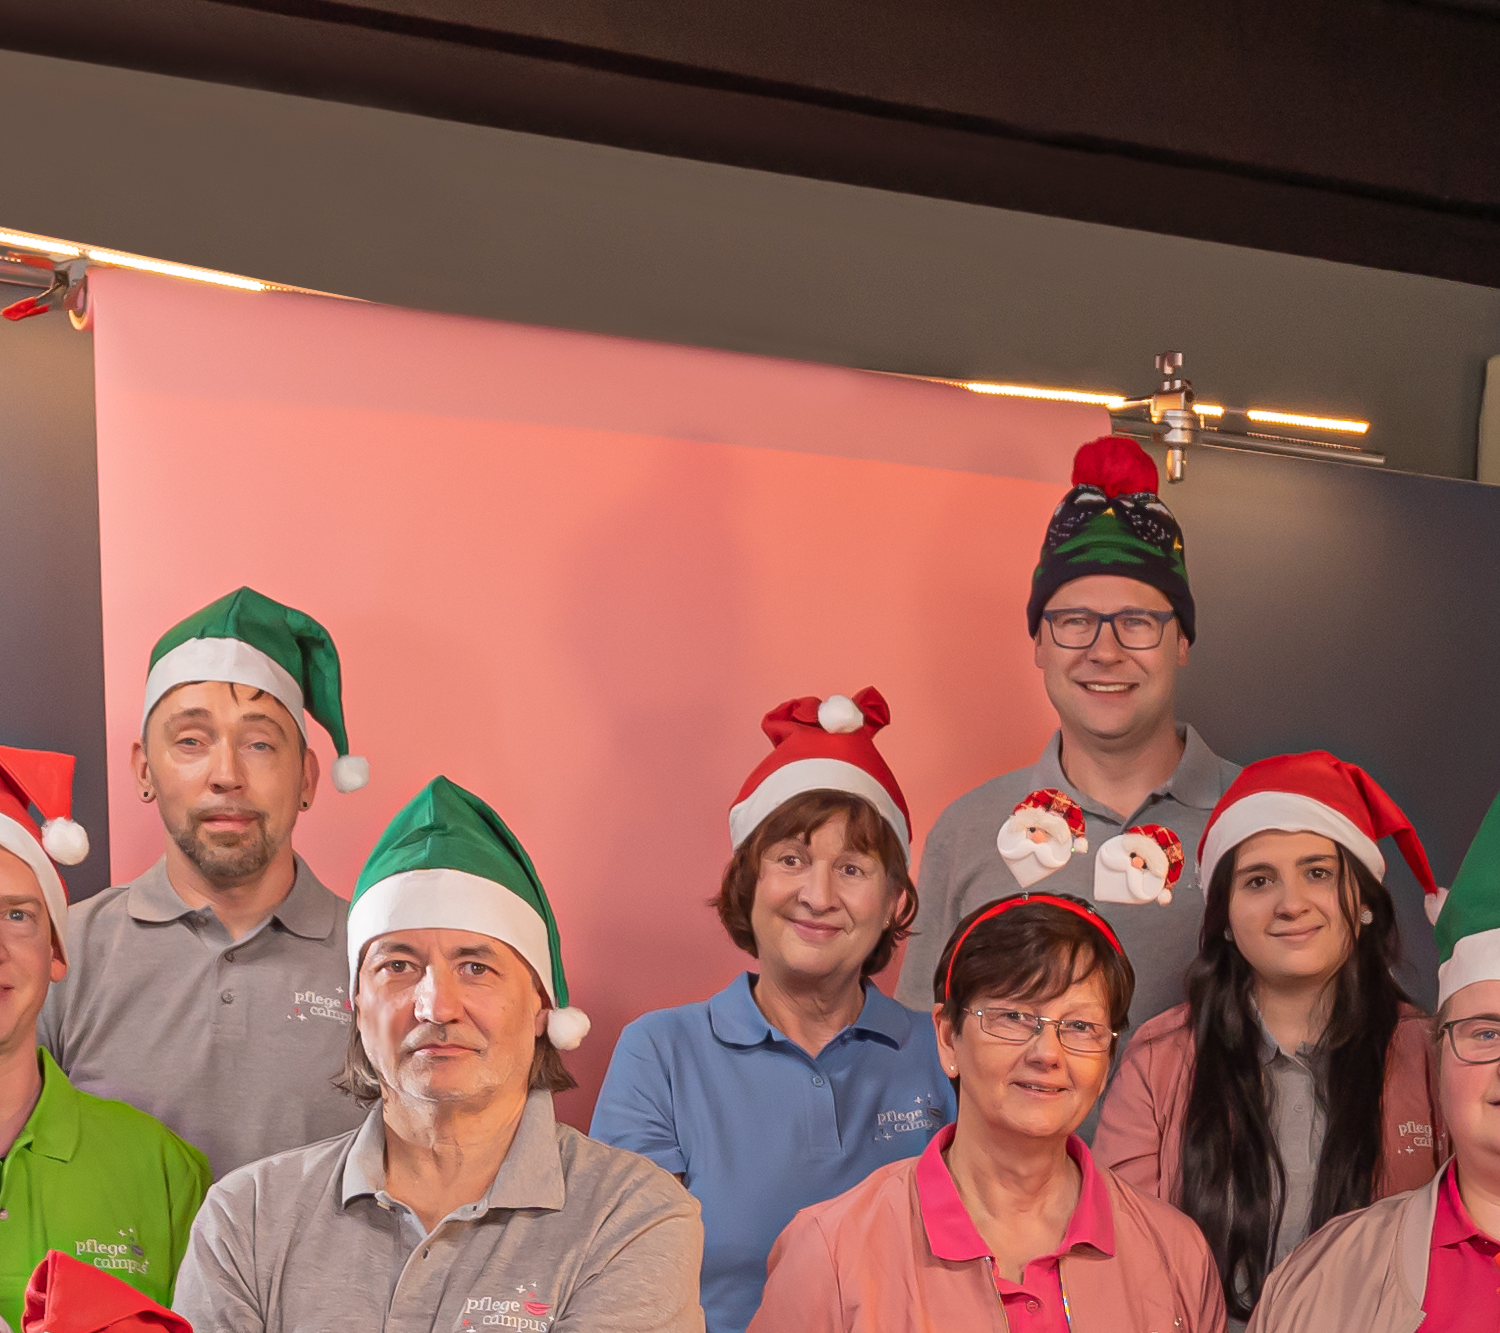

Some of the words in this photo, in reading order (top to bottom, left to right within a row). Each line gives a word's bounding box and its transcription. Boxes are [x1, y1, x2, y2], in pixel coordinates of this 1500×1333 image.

[294, 991, 341, 1008] pflege
[310, 1006, 352, 1024] camp
[877, 1110, 923, 1126] pflege
[1398, 1121, 1433, 1138] pfleg
[75, 1239, 128, 1258] pflege
[464, 1296, 521, 1314] pflege
[482, 1314, 548, 1333] campus
